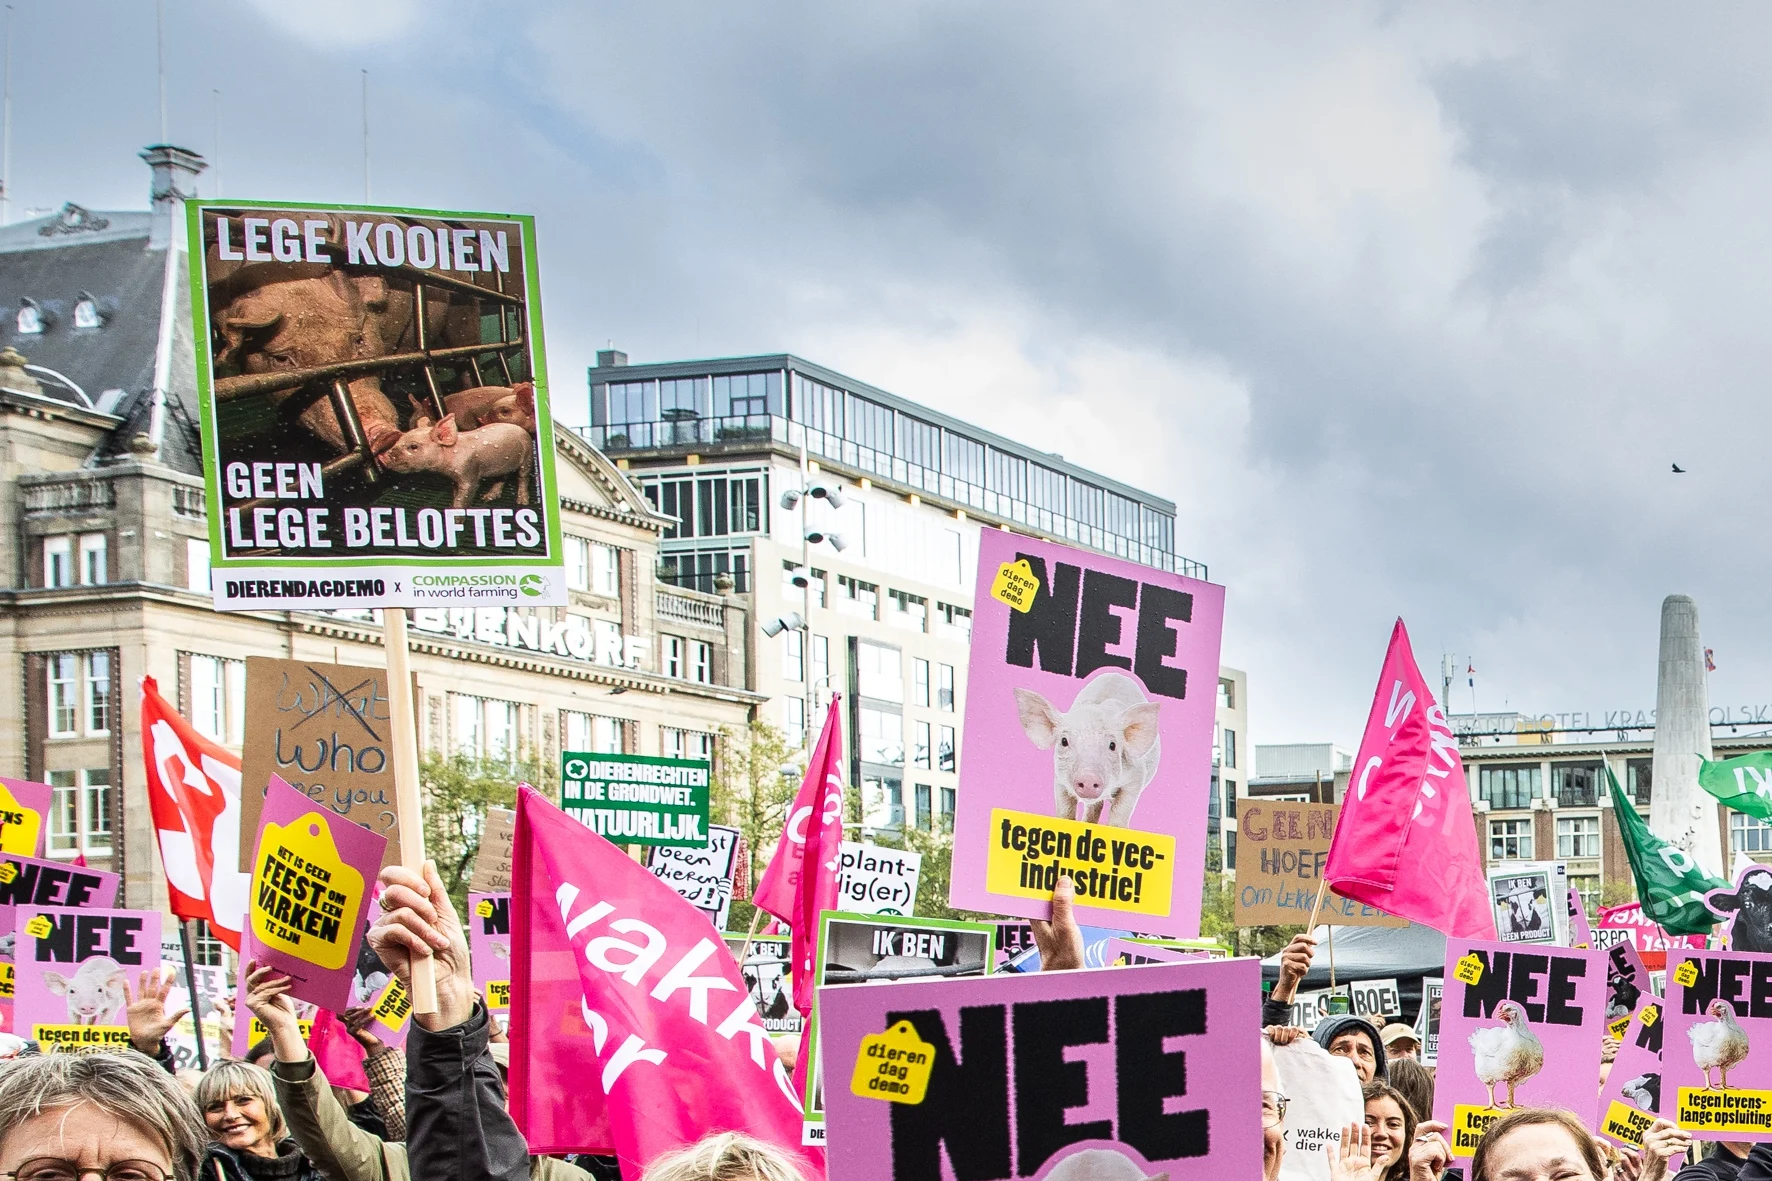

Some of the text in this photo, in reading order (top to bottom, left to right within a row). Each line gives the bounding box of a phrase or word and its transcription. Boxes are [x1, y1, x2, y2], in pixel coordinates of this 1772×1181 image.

[217, 217, 510, 273] LEGE KOOIEN
[226, 461, 323, 500] GEEN
[229, 506, 541, 548] LEGE BELOFTES
[226, 578, 385, 599] DIERENDAGDEMO
[412, 574, 516, 587] COMPASSION
[413, 586, 518, 600] in world farming
[1001, 568, 1036, 593] dieren
[1006, 582, 1024, 597] dag
[1000, 590, 1023, 607] demo
[1004, 551, 1195, 701] NEE
[1521, 711, 1596, 732] HOTEL
[275, 728, 387, 774] Who
[589, 762, 708, 788] DIERENRECHTEN
[333, 788, 390, 815] you
[564, 781, 697, 807] IN DE GRONDWET.
[564, 807, 708, 841] NATUURLIJK.
[1242, 806, 1332, 842] GEEN
[1001, 818, 1165, 870] tegen de vee-
[278, 845, 332, 883] HET IS GEEN
[840, 853, 916, 878] plant-
[261, 853, 346, 906] FEEST OM
[1507, 877, 1532, 888] IK BEN
[257, 884, 341, 944] VARKEN
[321, 902, 344, 919] EEN
[35, 912, 143, 966] NEE
[264, 918, 301, 946] TE ZIJN
[871, 929, 946, 960] IK BEN
[1501, 928, 1551, 943] GEEN PRODUCT
[760, 942, 783, 958] BEN
[1462, 949, 1587, 1027] NEE
[1353, 987, 1399, 1017] BOE!
[38, 1027, 100, 1043] tegen de
[866, 1042, 928, 1066] dieren
[877, 1061, 909, 1083] dag
[868, 1075, 910, 1096] demo
[1688, 1092, 1768, 1110] tegen levens-
[1680, 1107, 1772, 1129] lange opsluiting
[1295, 1138, 1323, 1152] dier
[1296, 1127, 1341, 1143] wakke
